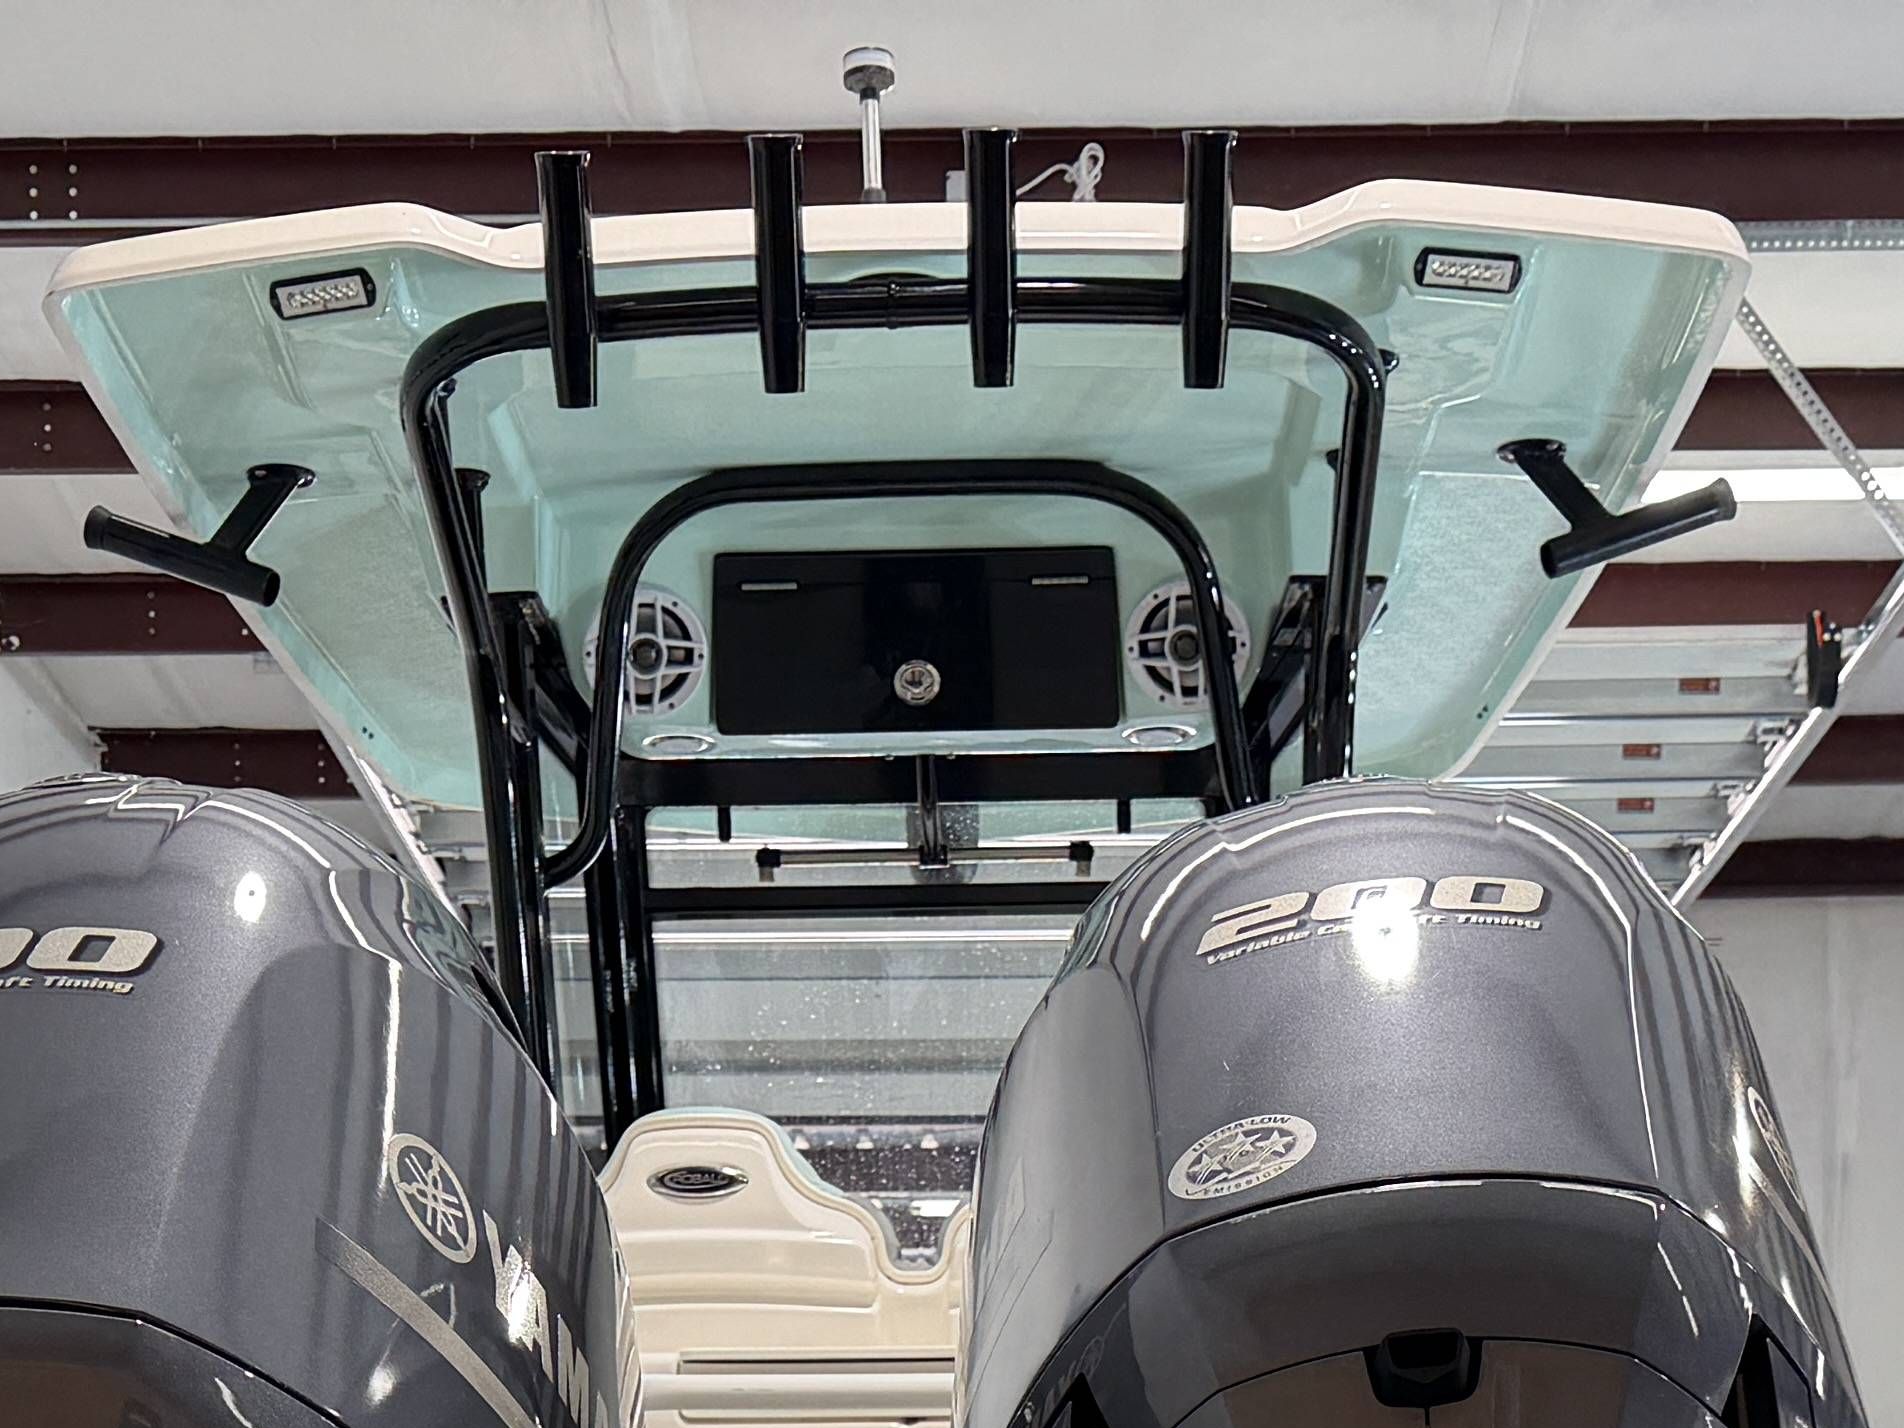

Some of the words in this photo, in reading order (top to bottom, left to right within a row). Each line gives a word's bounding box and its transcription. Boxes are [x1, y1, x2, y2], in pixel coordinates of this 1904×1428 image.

[1195, 875, 1545, 956] 200
[1207, 930, 1311, 966] Variable
[1454, 913, 1542, 931] Timing
[43, 975, 134, 995] Timing
